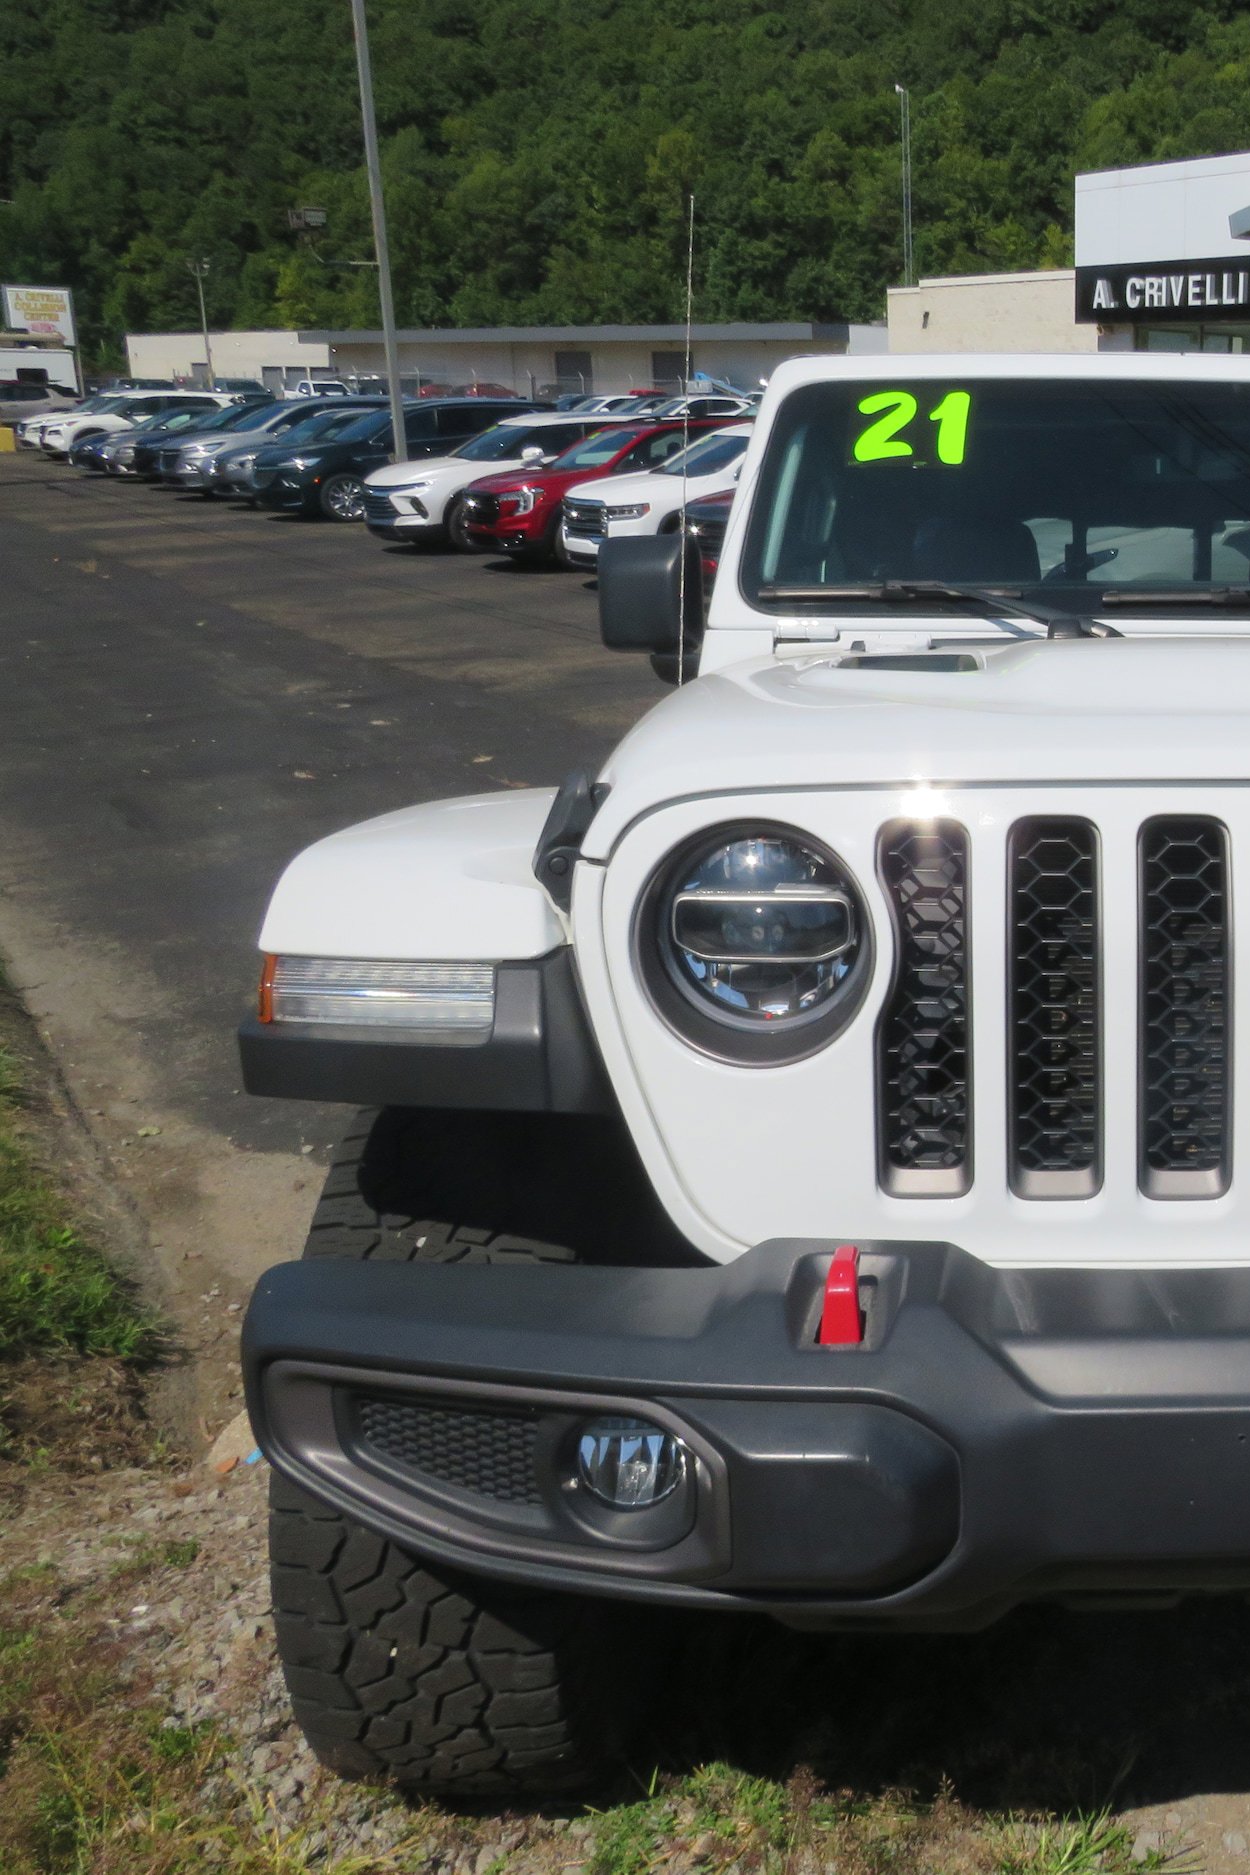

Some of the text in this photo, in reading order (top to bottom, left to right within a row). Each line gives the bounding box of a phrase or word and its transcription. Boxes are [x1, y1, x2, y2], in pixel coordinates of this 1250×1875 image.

[1093, 272, 1248, 309] A. CRIVELLI
[854, 391, 971, 465] 21
